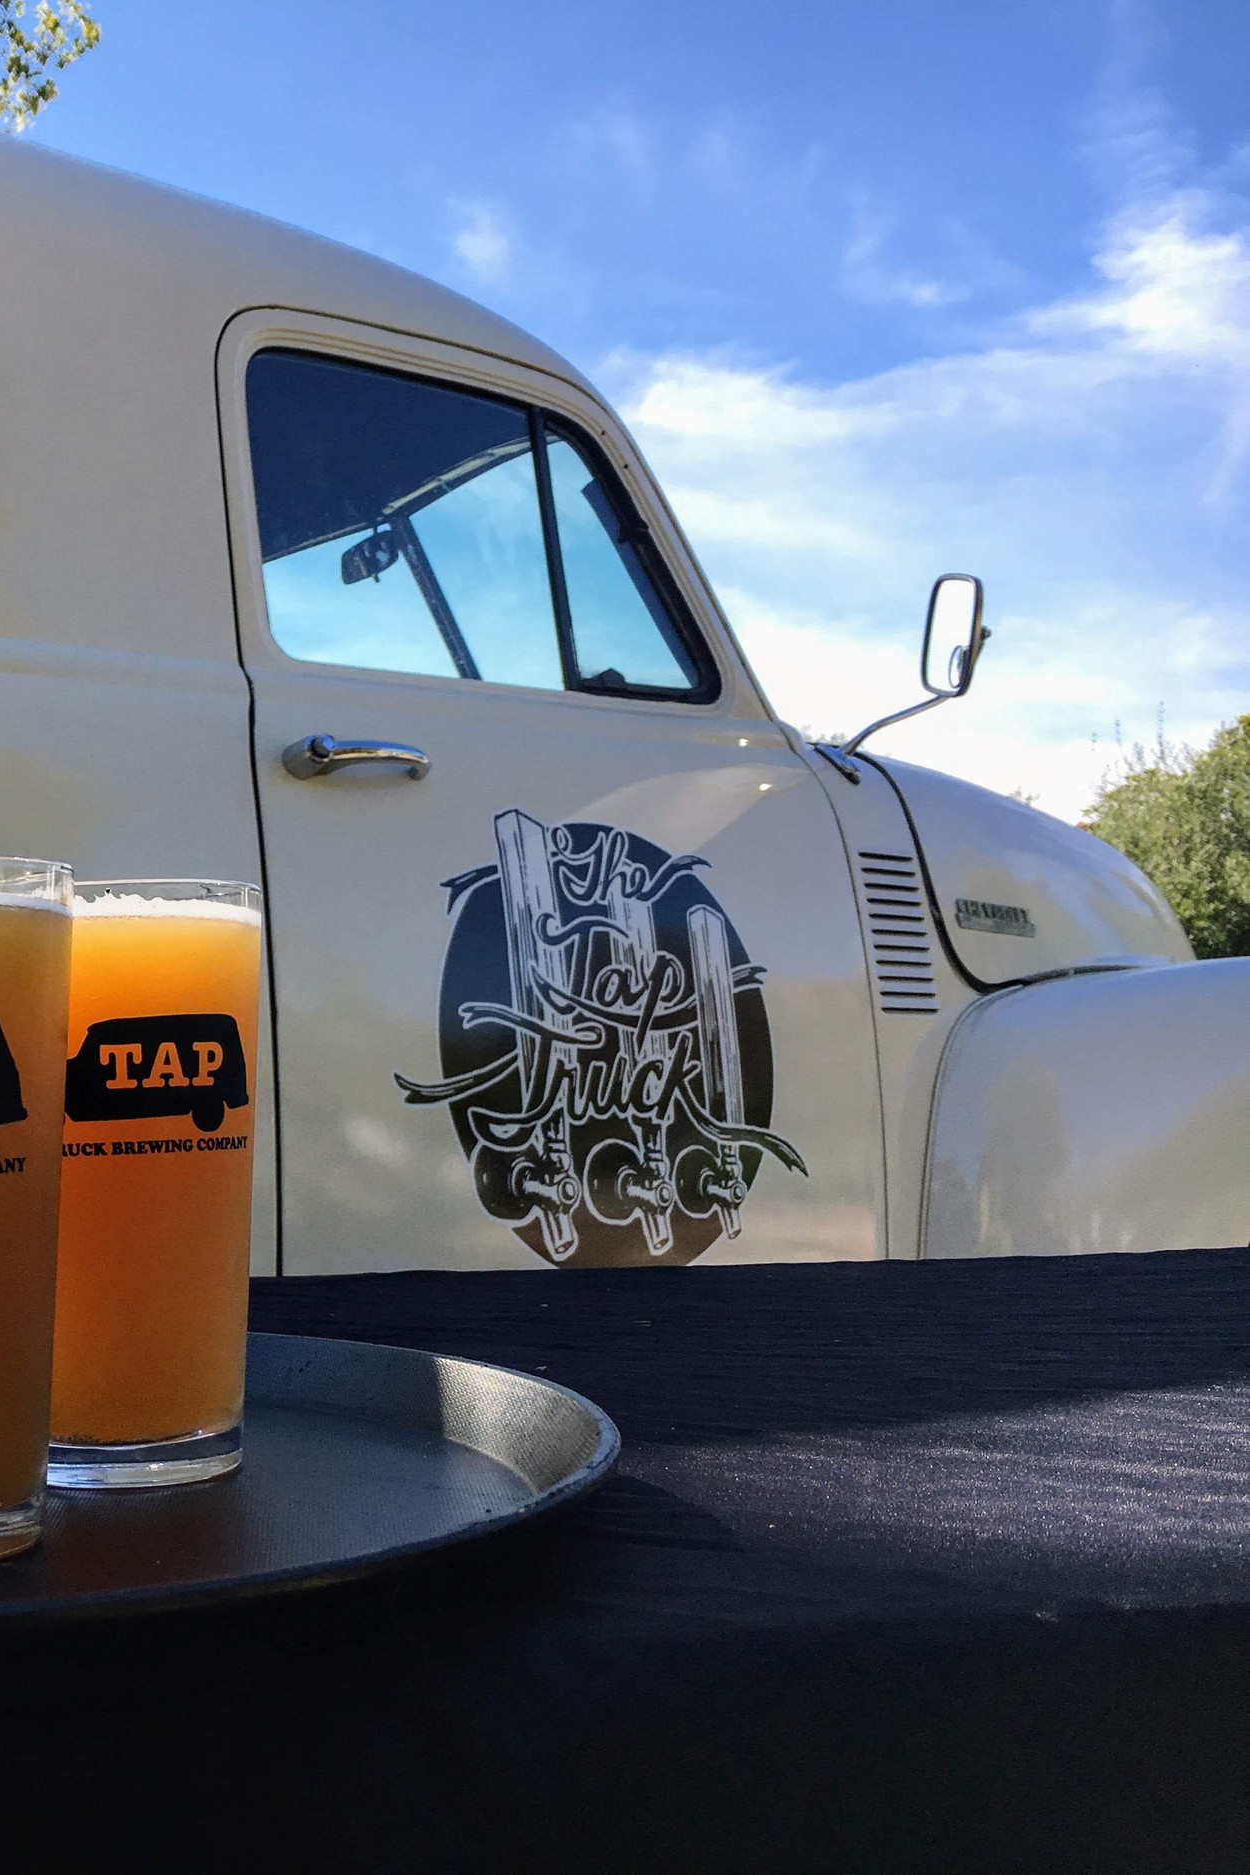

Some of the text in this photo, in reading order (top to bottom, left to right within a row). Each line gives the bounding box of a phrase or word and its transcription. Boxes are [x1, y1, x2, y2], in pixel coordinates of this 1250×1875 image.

[550, 824, 712, 906] The
[536, 912, 687, 1052] Tap
[99, 1041, 224, 1090] TAP
[458, 1003, 705, 1150] Truck
[111, 1138, 193, 1156] BREWING
[196, 1136, 248, 1152] COMPANY
